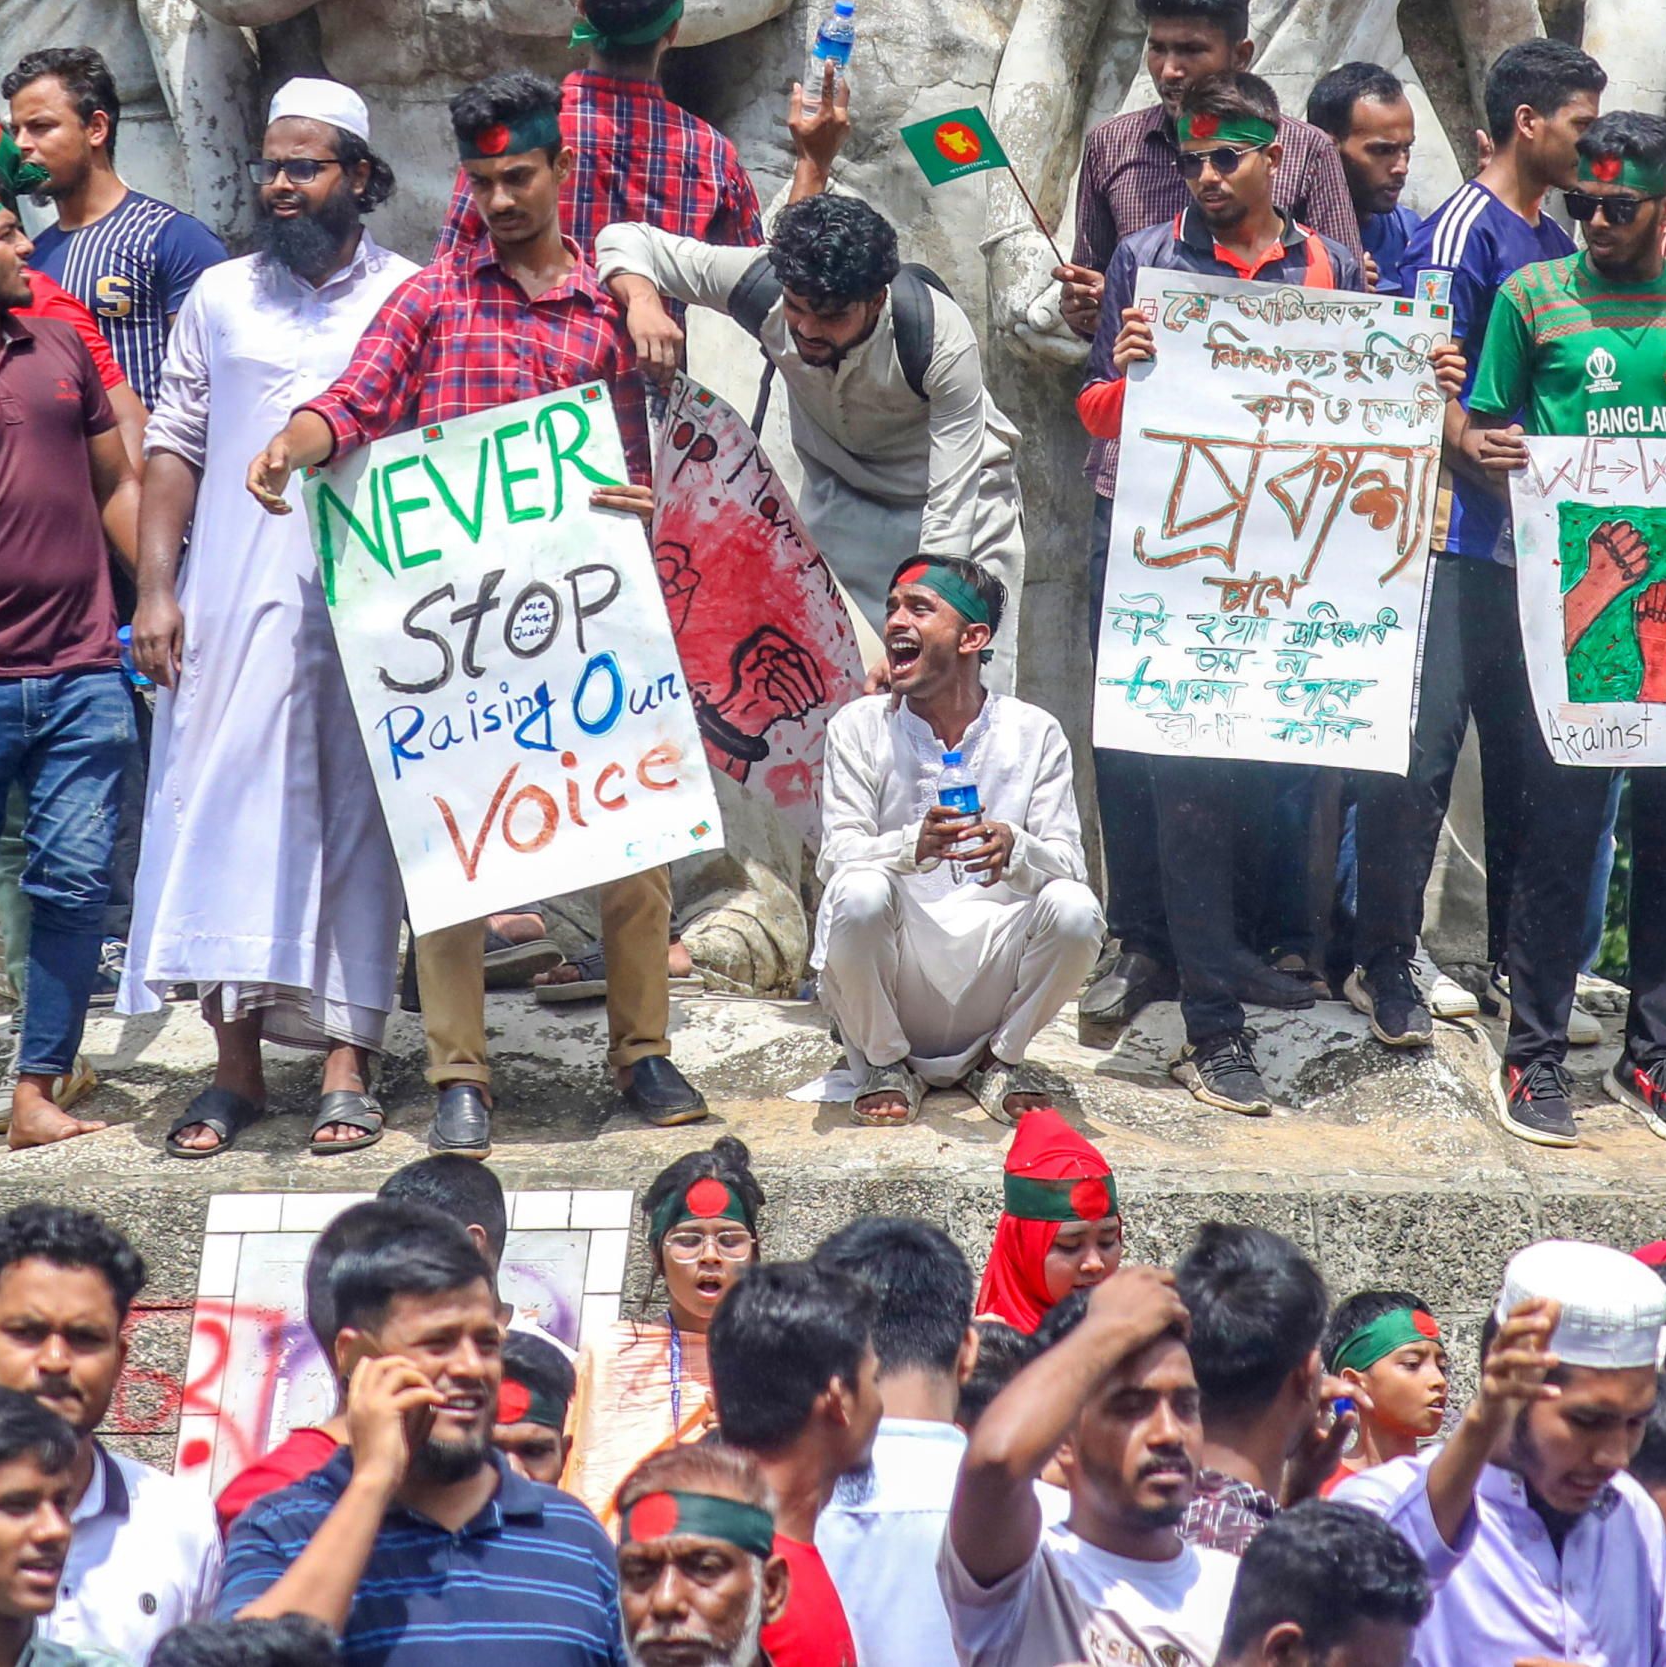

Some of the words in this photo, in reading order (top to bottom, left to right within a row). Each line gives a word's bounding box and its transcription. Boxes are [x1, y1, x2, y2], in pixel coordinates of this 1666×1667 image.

[1232, 378, 1333, 427] কবি
[1523, 437, 1617, 498] WE
[316, 401, 621, 605] NEVER
[1133, 429, 1440, 588] প্রকাশ্য
[375, 681, 558, 779] Raising
[572, 649, 685, 741] Our
[434, 742, 681, 881] Voice
